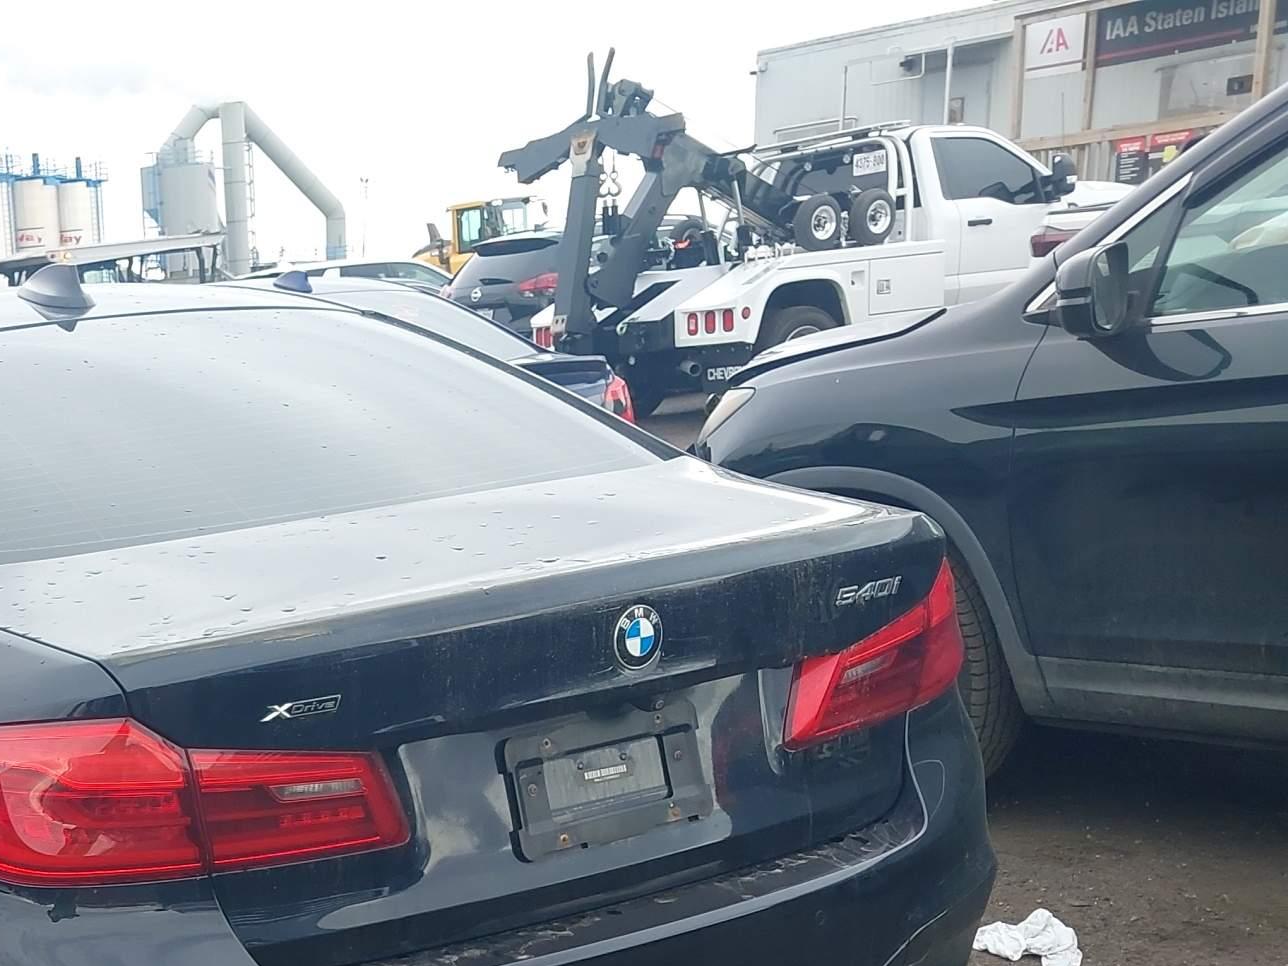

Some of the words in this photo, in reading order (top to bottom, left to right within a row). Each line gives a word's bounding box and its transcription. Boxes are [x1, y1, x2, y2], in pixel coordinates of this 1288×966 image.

[1106, 15, 1139, 41] IAA
[1144, 5, 1205, 33] Staten
[1211, 0, 1260, 20] Islan
[835, 576, 902, 607] 540i
[621, 607, 659, 630] BMW
